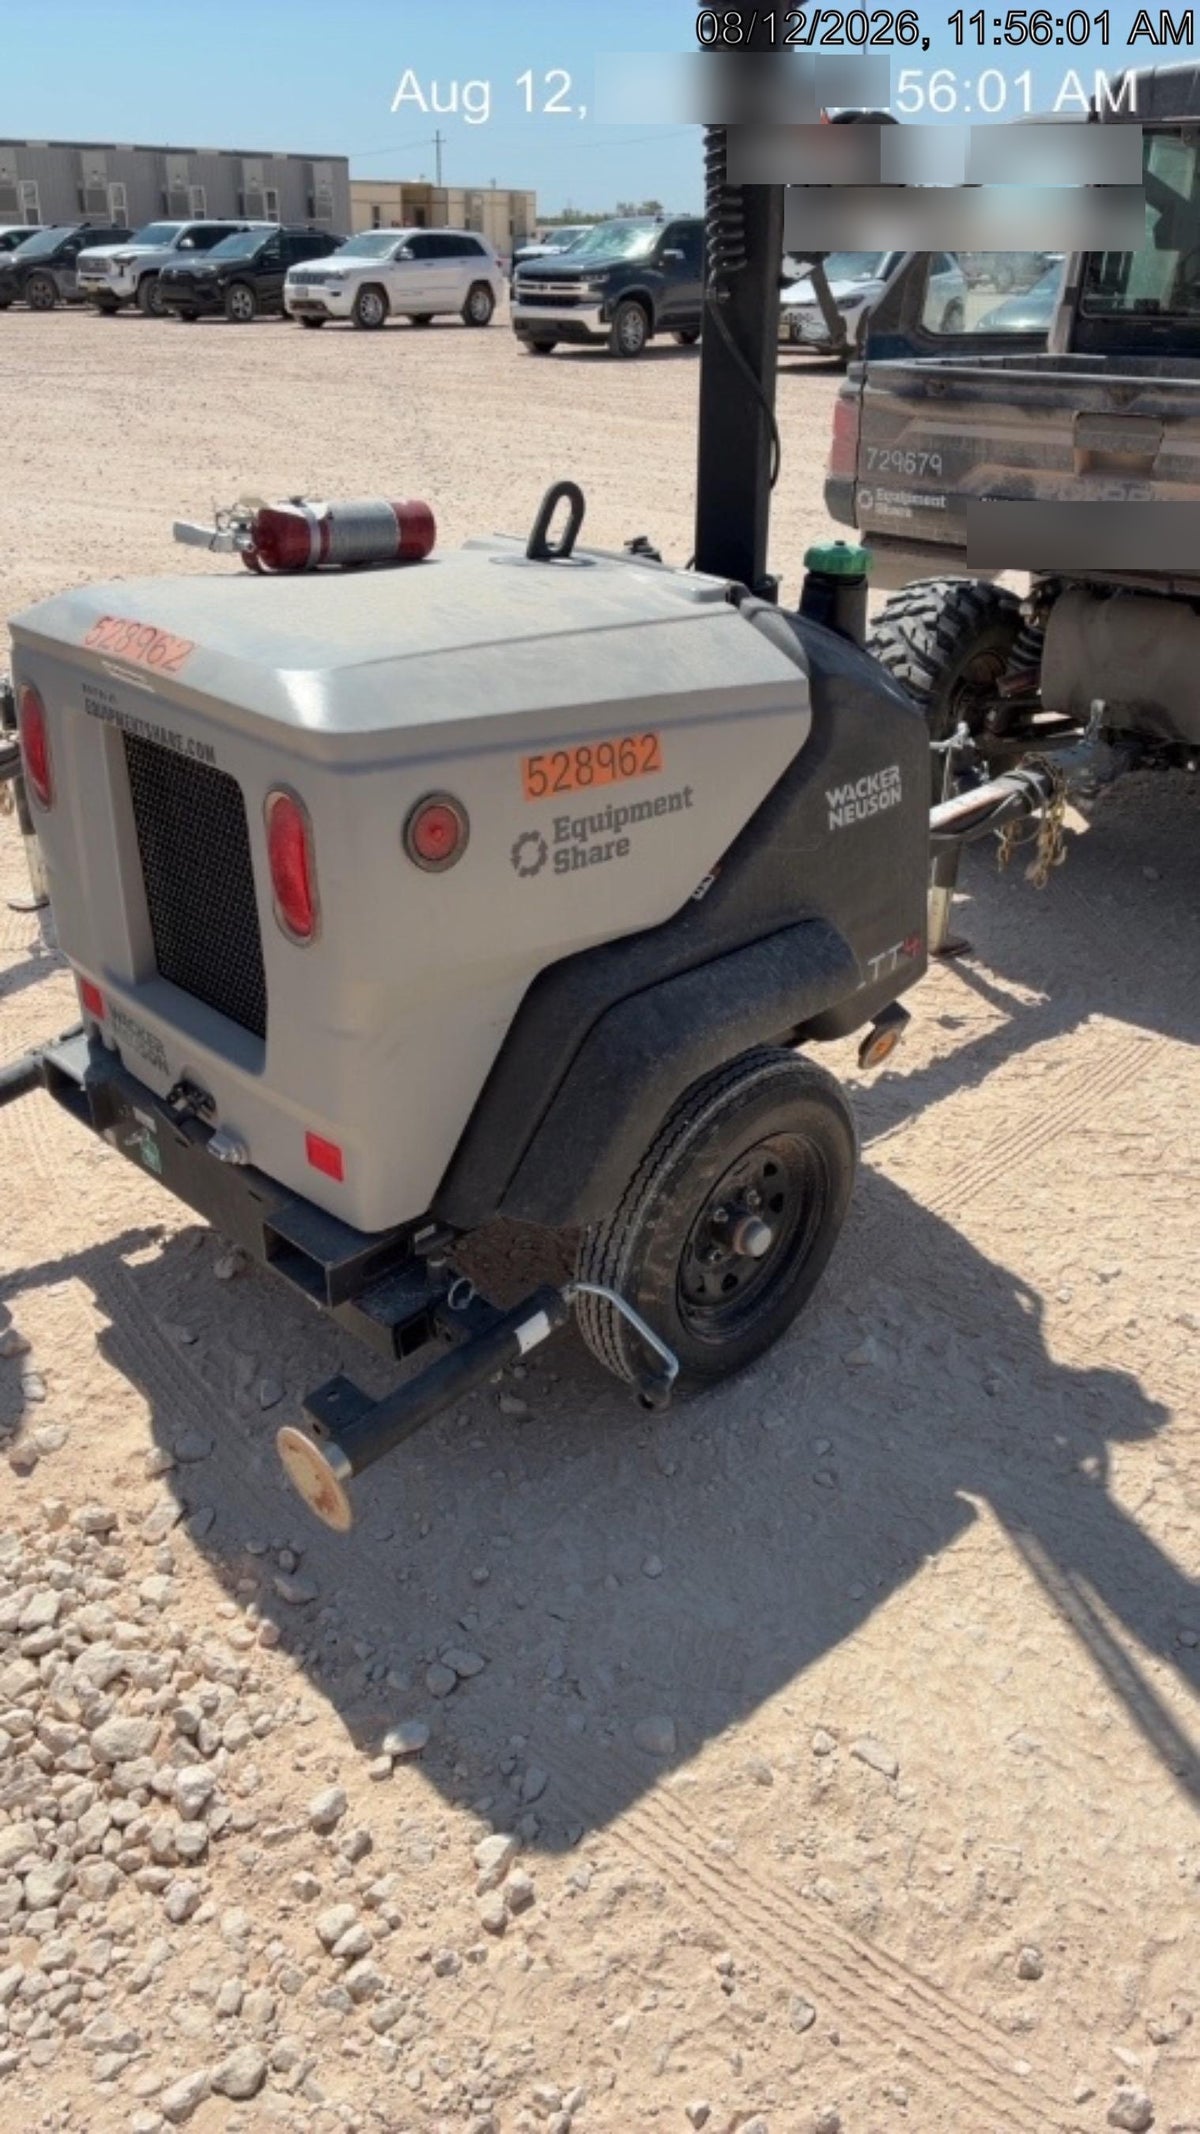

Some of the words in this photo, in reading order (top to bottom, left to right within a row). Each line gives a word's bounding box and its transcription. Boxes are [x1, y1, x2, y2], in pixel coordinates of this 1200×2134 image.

[866, 447, 943, 476] 729679
[84, 615, 196, 672] 528962
[527, 733, 661, 797] 528962
[825, 765, 901, 809] WACKER
[552, 785, 694, 844] Equipment
[828, 783, 902, 831] NEUSON
[553, 836, 631, 875] Share
